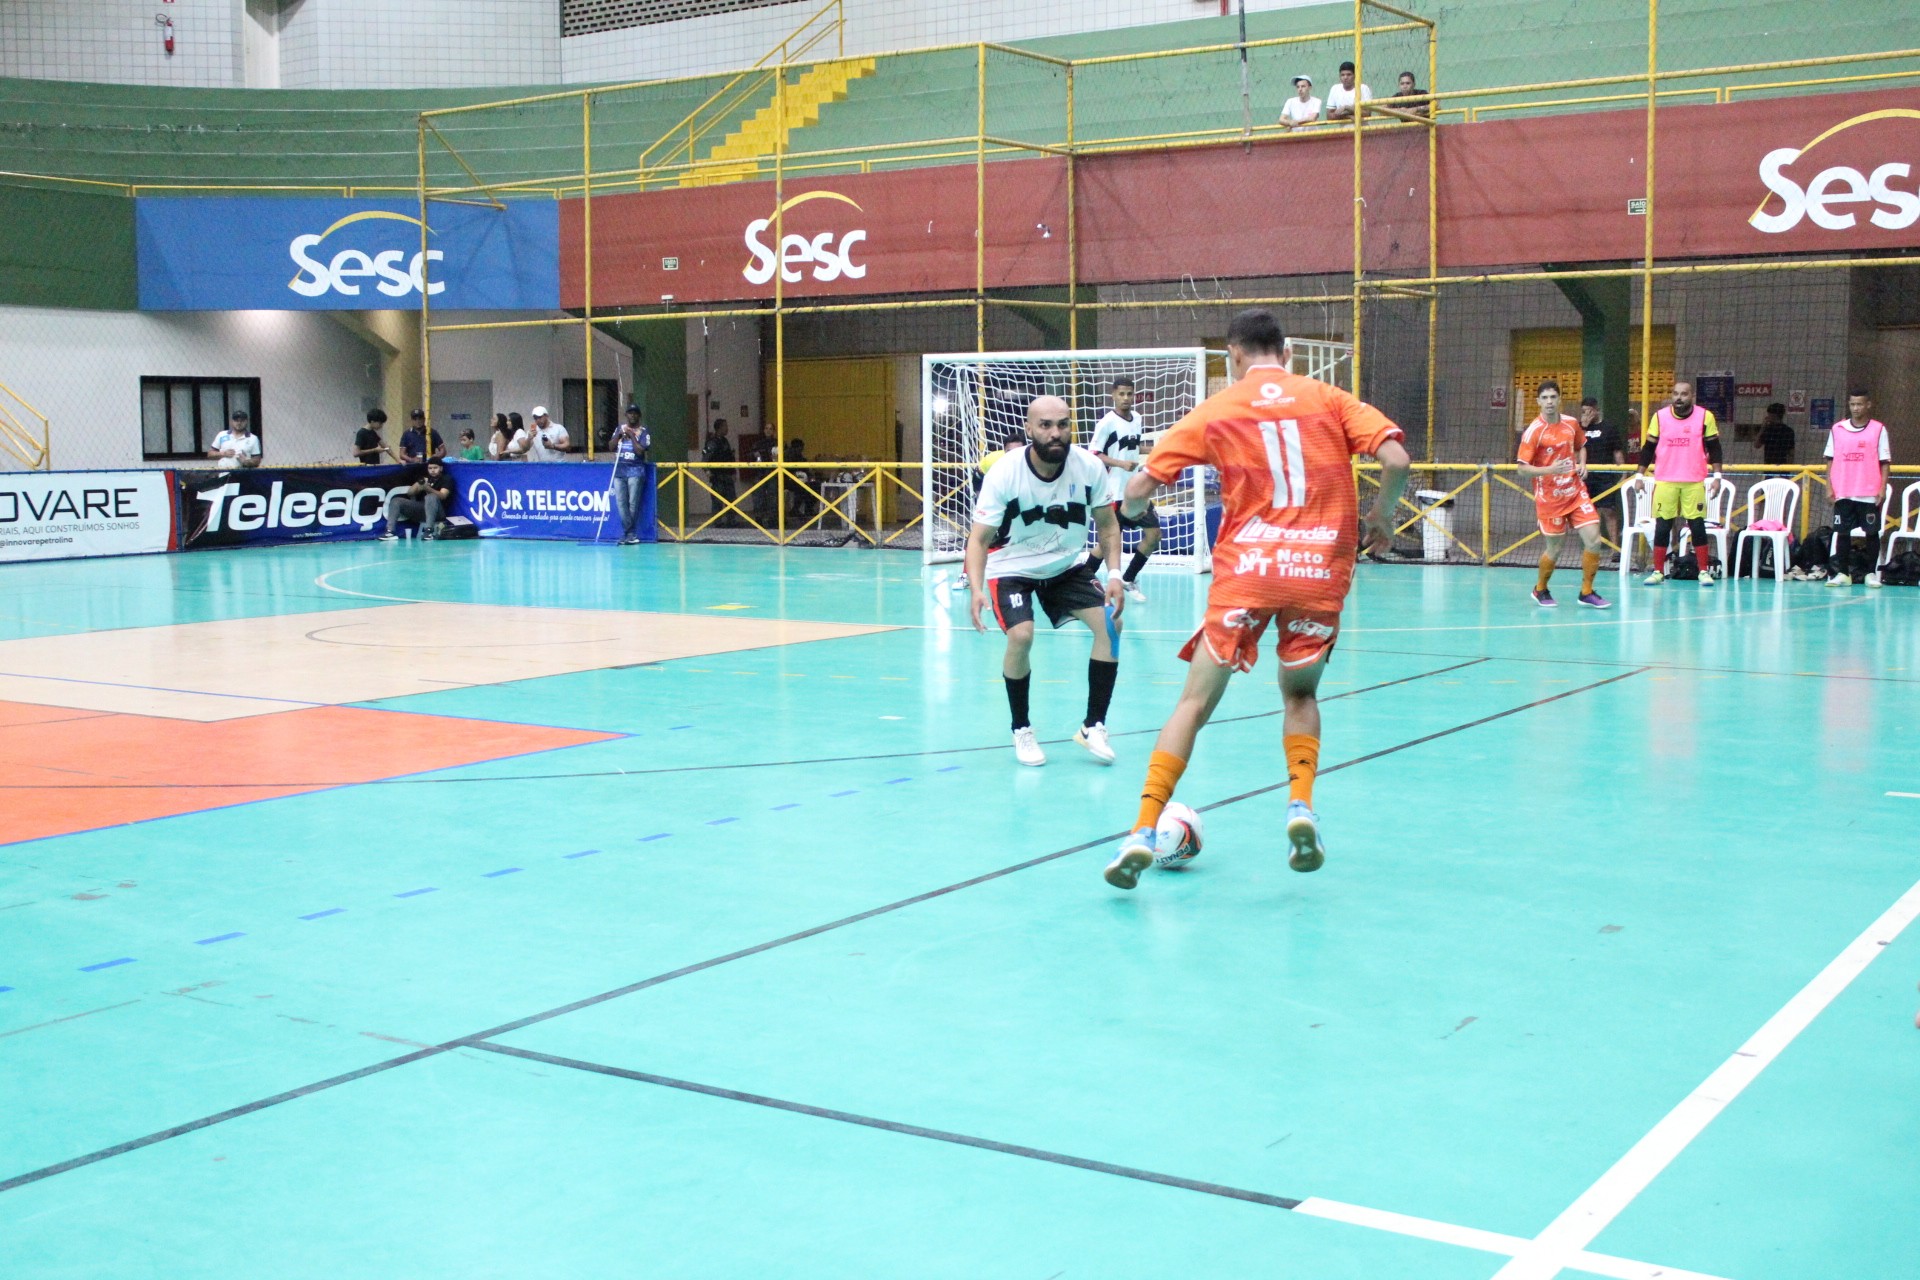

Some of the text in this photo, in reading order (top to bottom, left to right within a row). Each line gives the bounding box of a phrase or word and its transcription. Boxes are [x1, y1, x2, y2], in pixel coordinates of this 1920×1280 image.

[1748, 147, 1920, 233] Ses
[743, 218, 867, 285] Sesc
[288, 233, 446, 297] Sesc
[1738, 386, 1769, 395] CAIXA
[1258, 419, 1306, 509] 11
[501, 489, 611, 512] JR TELECOM
[1657, 503, 1662, 511] 2
[23, 525, 43, 535] AQUI
[45, 522, 105, 534] CONSTRUÍMOS
[107, 521, 140, 531] SONHOS
[1276, 549, 1324, 564] Neto
[1277, 563, 1332, 579] Tintas
[1009, 593, 1024, 608] 10
